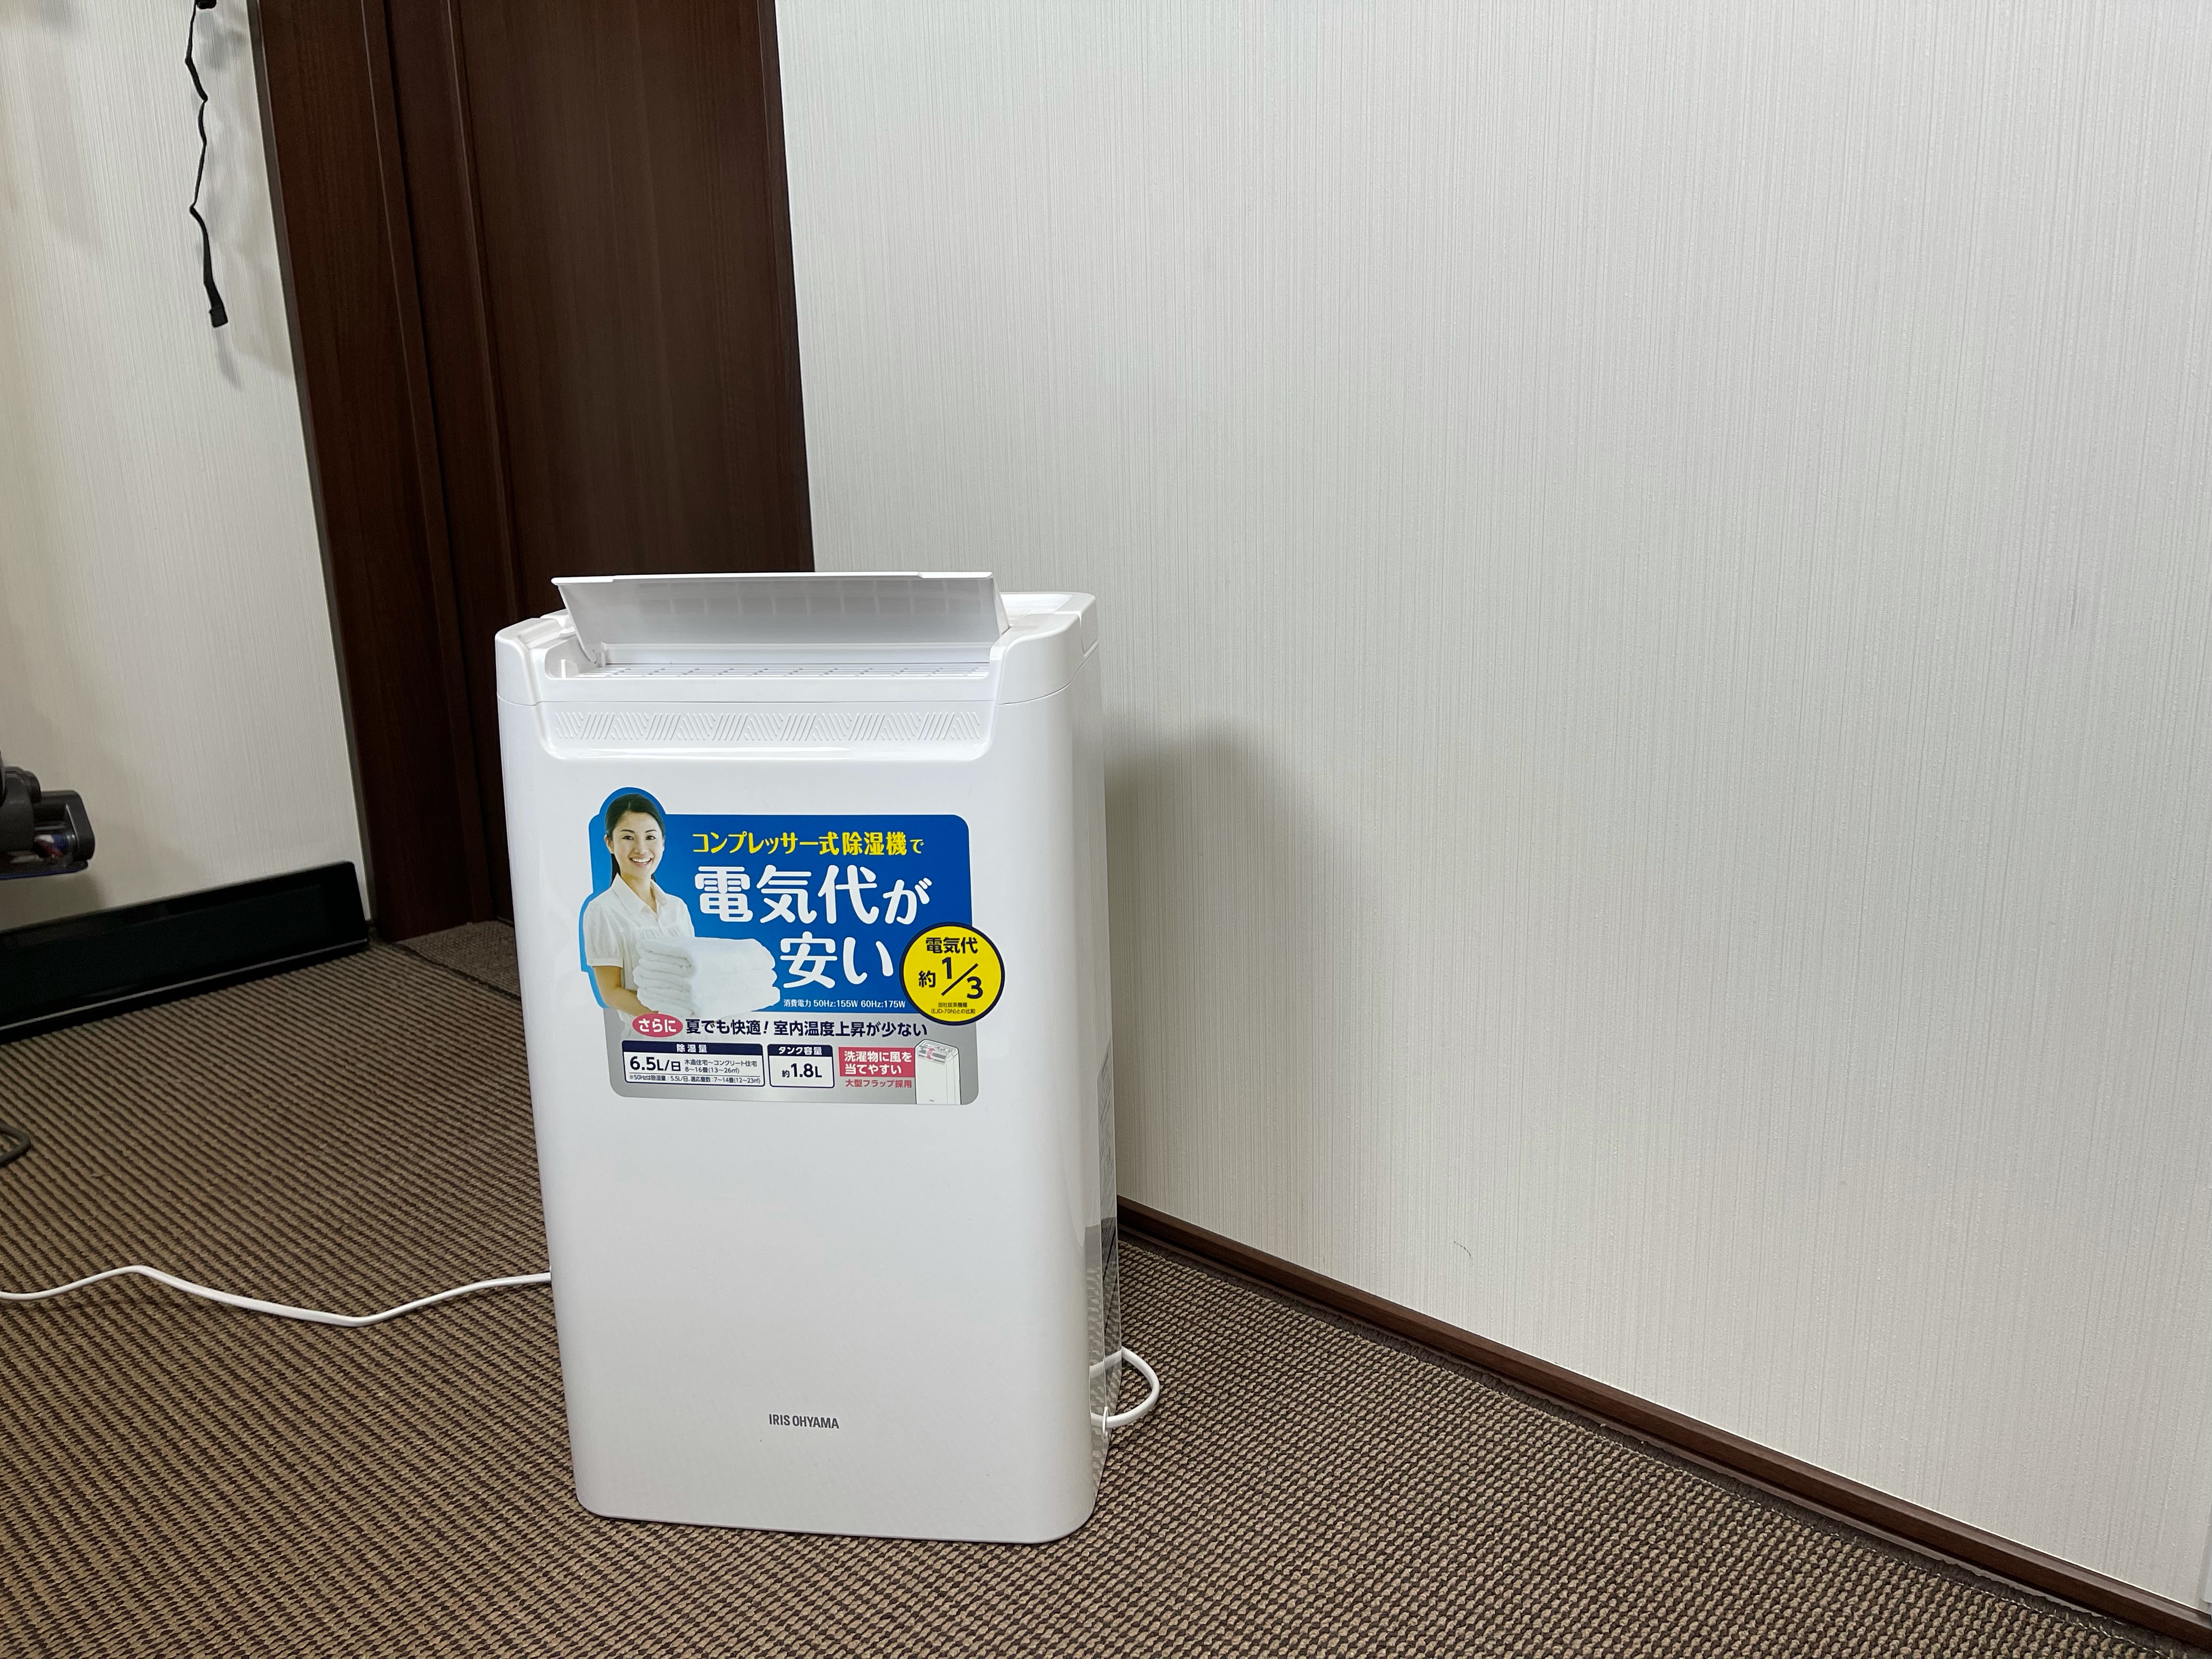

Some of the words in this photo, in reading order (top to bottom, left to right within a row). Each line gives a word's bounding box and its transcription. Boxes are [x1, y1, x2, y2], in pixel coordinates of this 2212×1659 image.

[692, 831, 924, 856] コンプレッサー式除湿機で
[695, 864, 932, 925] 電気代が
[926, 937, 979, 954] 電気代
[780, 931, 894, 989] 安い
[783, 998, 811, 1007] 消費電力
[813, 999, 859, 1008] 50Hz:155W
[860, 1000, 906, 1008] 60Hz:175W
[638, 1018, 677, 1033] さらに
[676, 1043, 708, 1053] 除湿量
[778, 1046, 823, 1056] タンク容量
[629, 1056, 681, 1072] 6.5L/日
[844, 1050, 912, 1063] 洗濯物に風を
[781, 1062, 822, 1079] 約1.8L
[844, 1063, 902, 1075] 当てやすい
[845, 1079, 912, 1088] 大型フラップ採用
[769, 1414, 791, 1426] IRIS
[792, 1415, 839, 1429] OHYAMA
